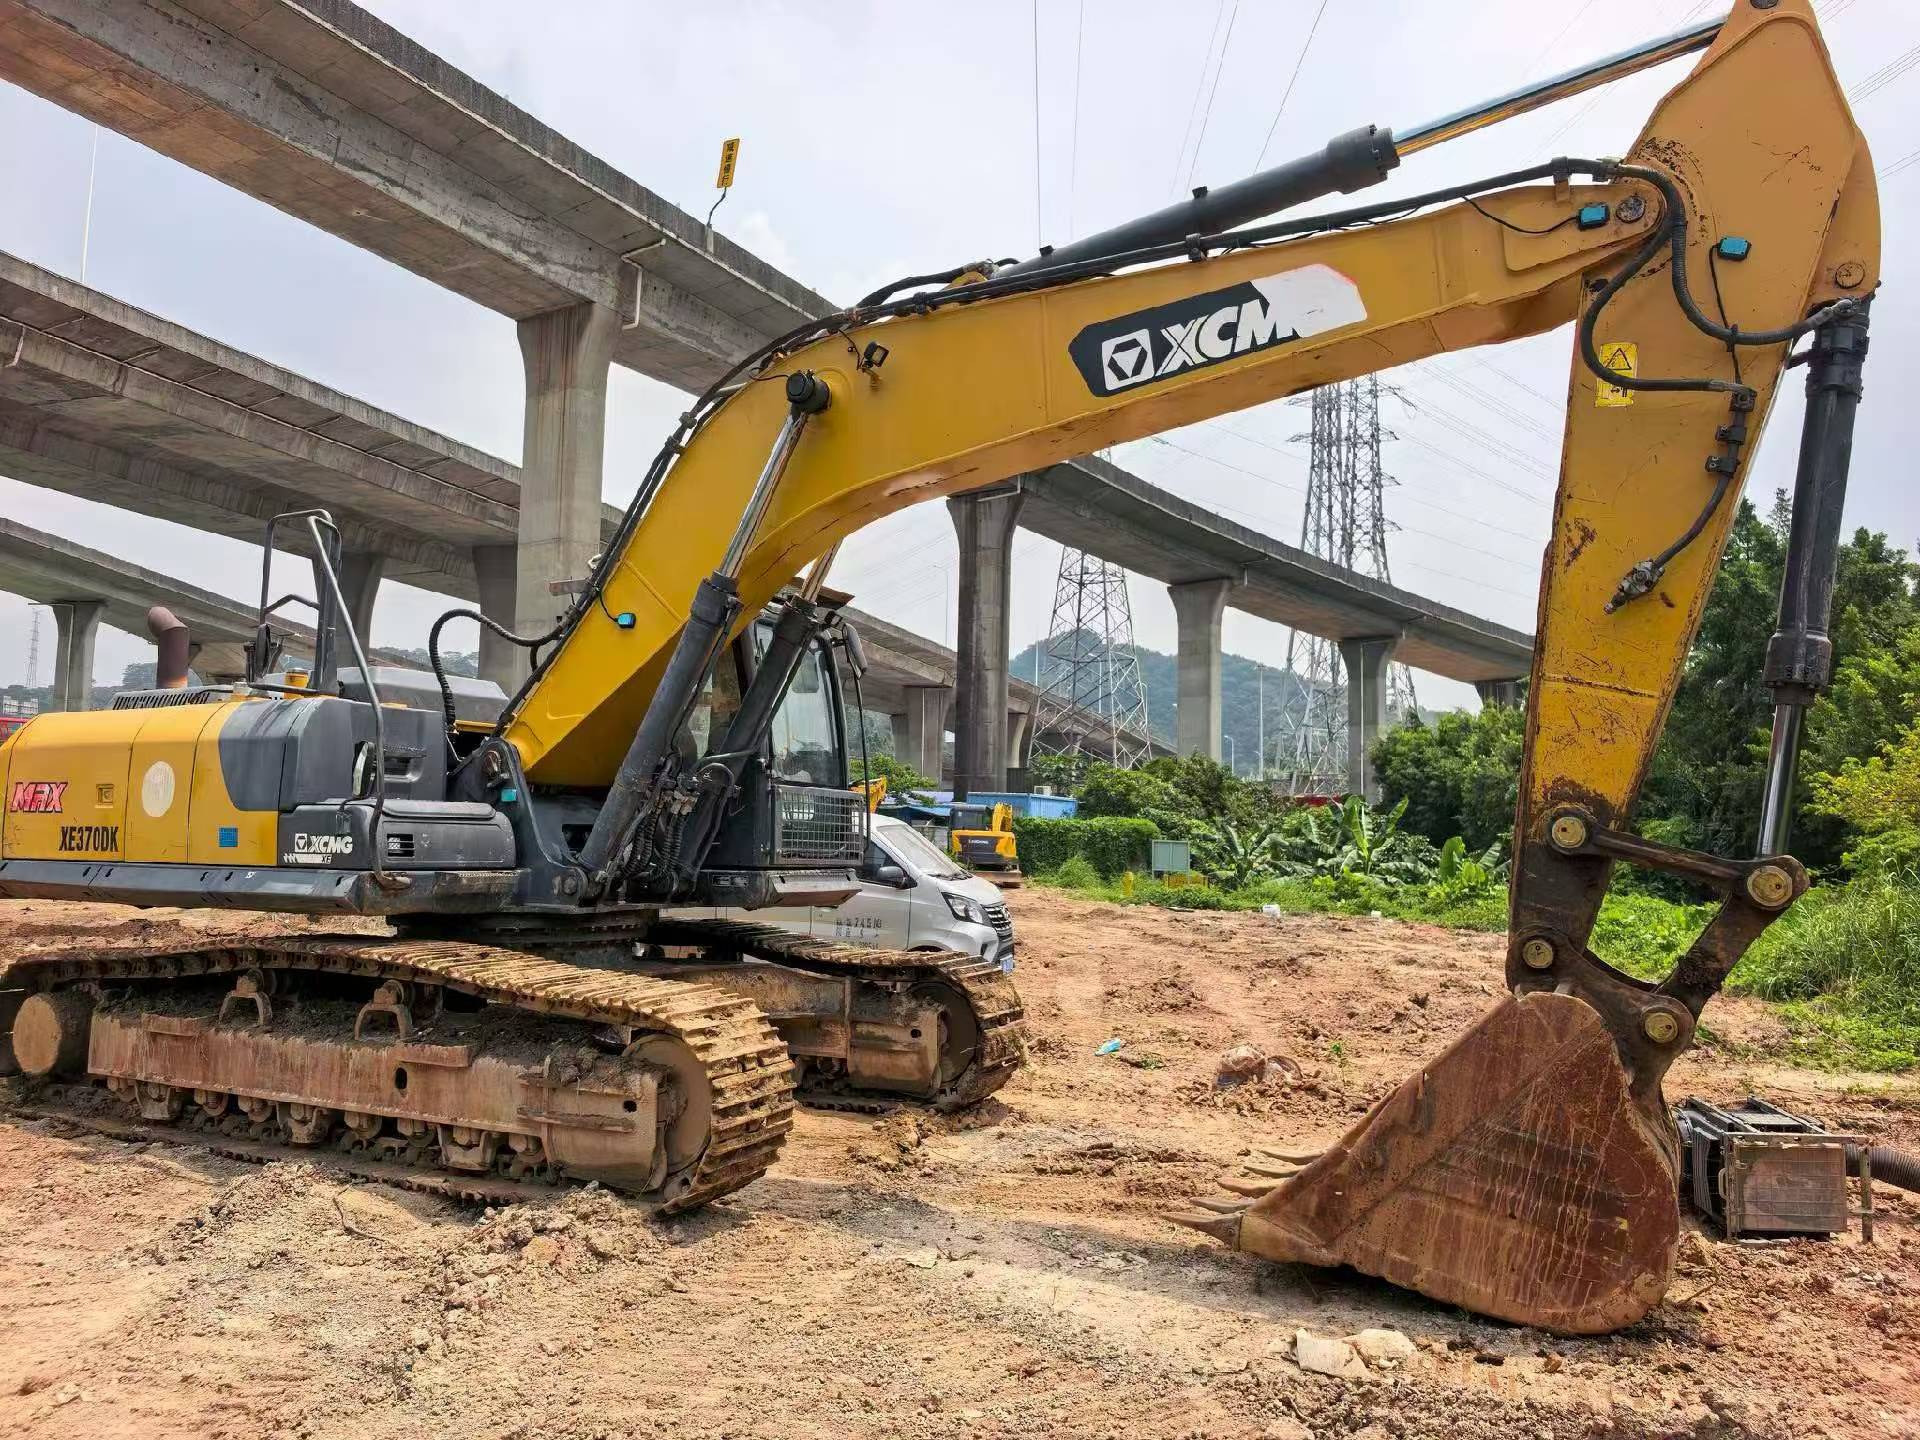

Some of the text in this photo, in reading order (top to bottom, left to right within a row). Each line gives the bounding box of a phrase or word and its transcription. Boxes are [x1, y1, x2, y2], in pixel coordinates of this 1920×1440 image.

[1155, 298, 1304, 377] XCM
[10, 782, 68, 813] MAX
[59, 826, 119, 852] XE370DK
[308, 835, 353, 854] XCMG
